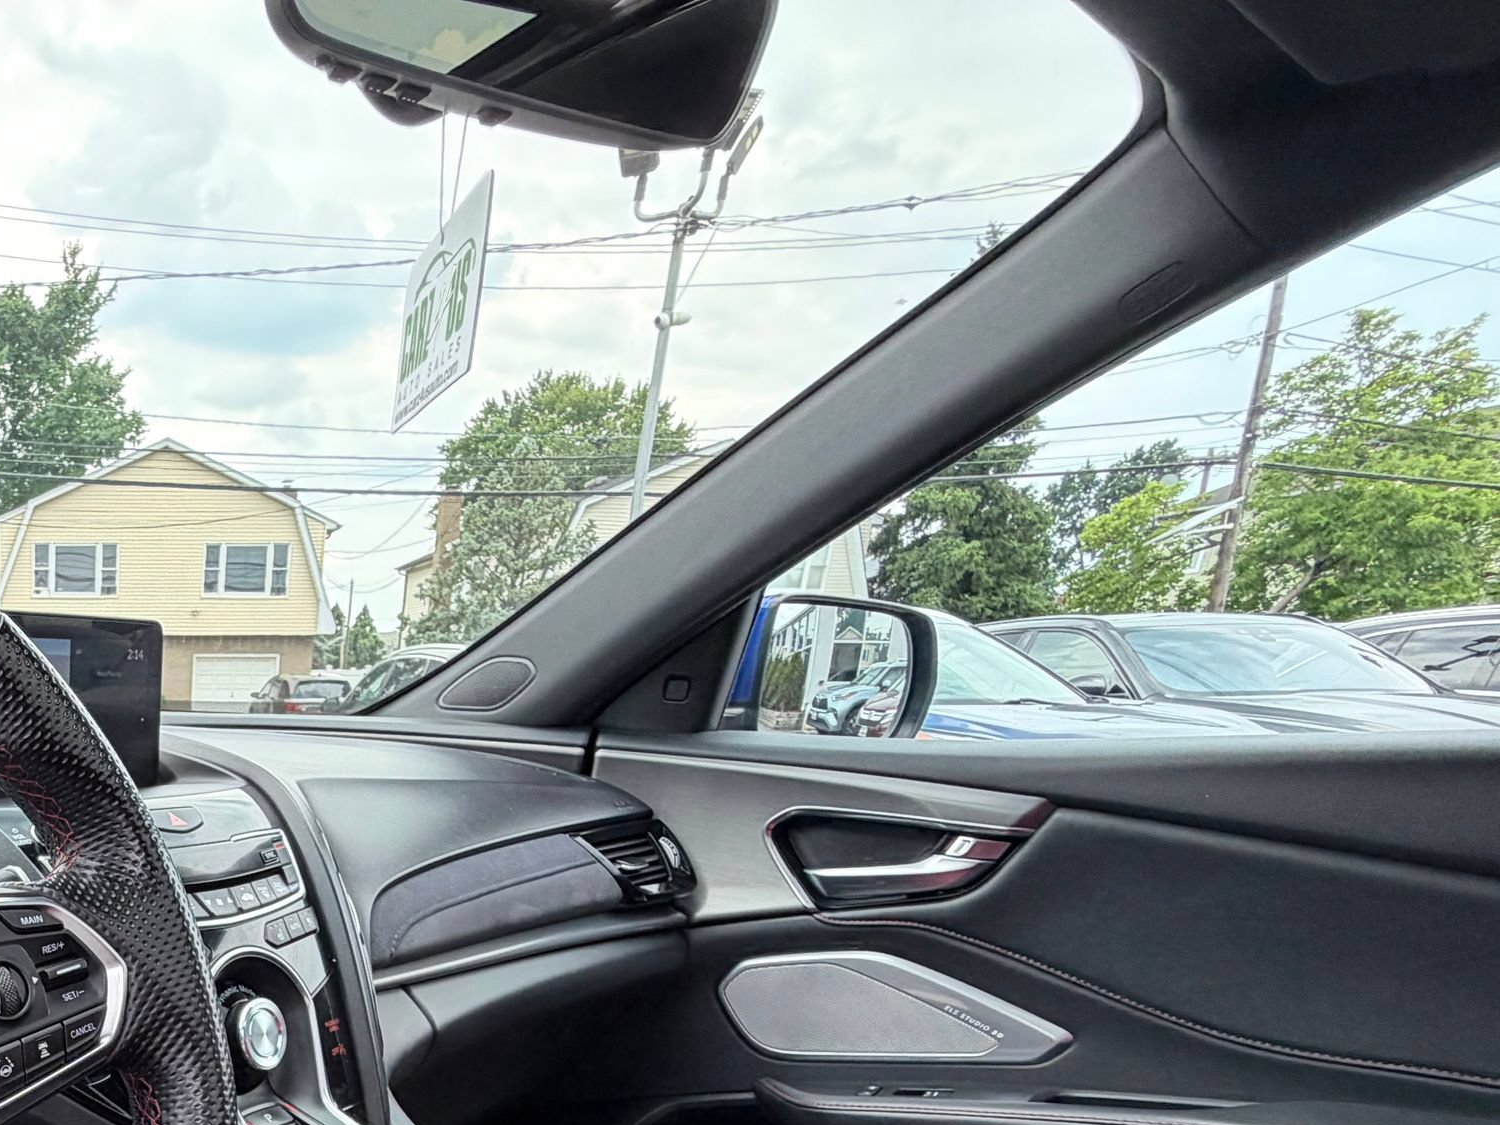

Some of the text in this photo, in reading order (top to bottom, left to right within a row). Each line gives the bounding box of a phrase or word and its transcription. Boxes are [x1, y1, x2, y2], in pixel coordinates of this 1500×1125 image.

[427, 335, 462, 379] SALES
[126, 649, 145, 660] 2:14
[20, 915, 44, 926] MAIN
[943, 1004, 960, 1016] ELS
[959, 1012, 990, 1032] STUDIO
[70, 1022, 97, 1040] CANCEL
